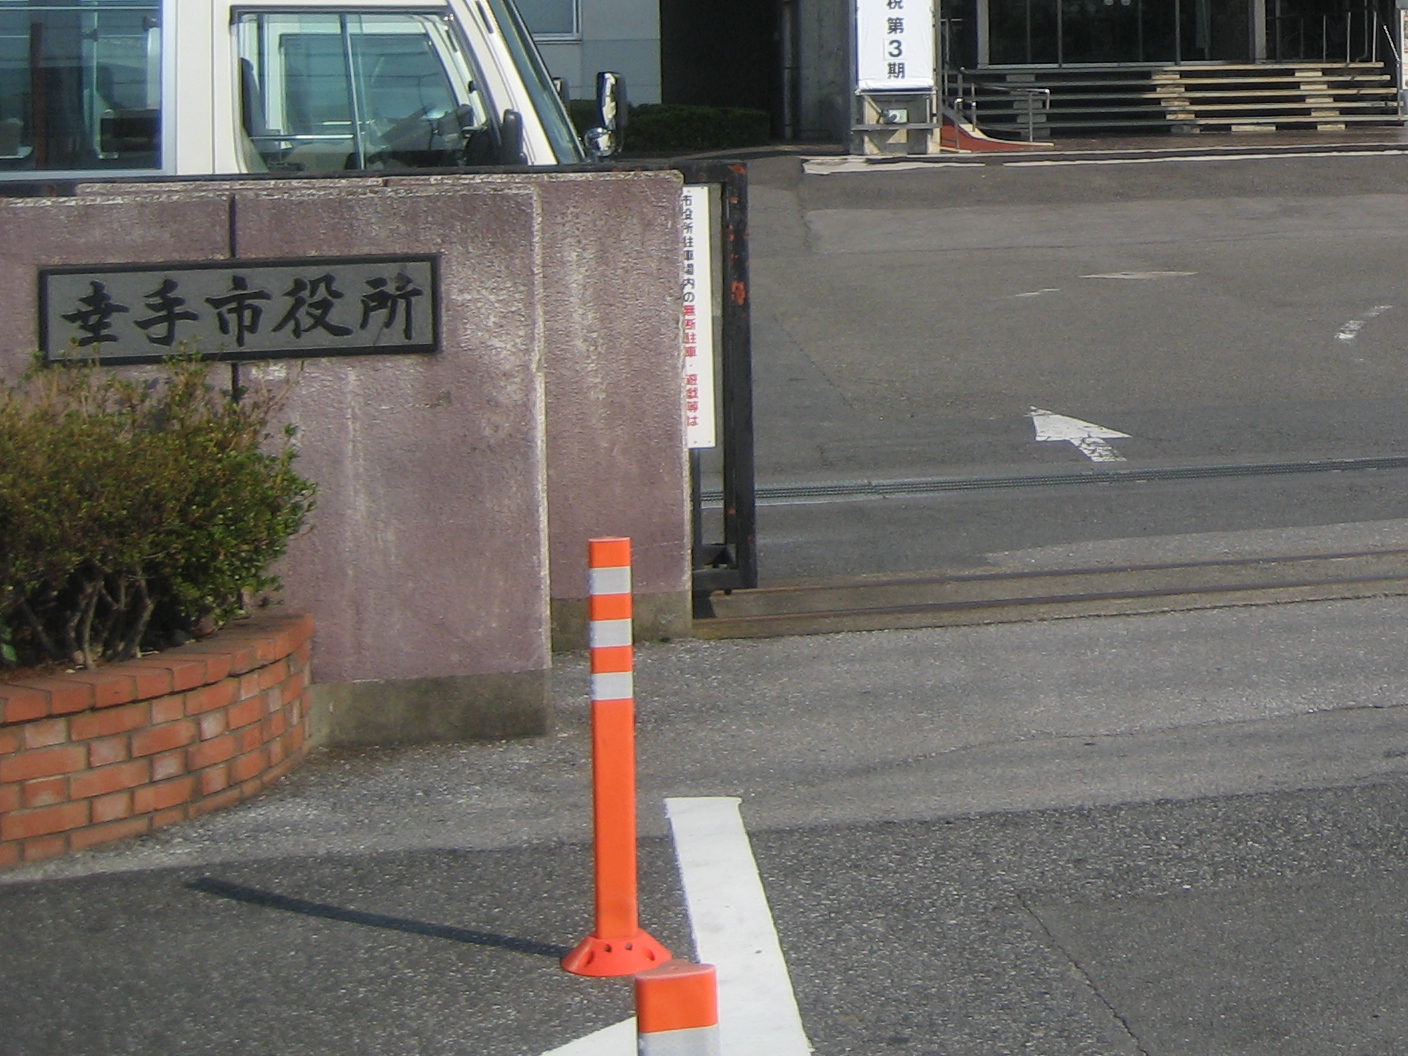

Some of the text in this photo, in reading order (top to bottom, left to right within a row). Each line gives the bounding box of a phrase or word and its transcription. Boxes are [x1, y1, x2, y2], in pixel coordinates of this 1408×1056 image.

[60, 272, 425, 347] 幸手市役所
